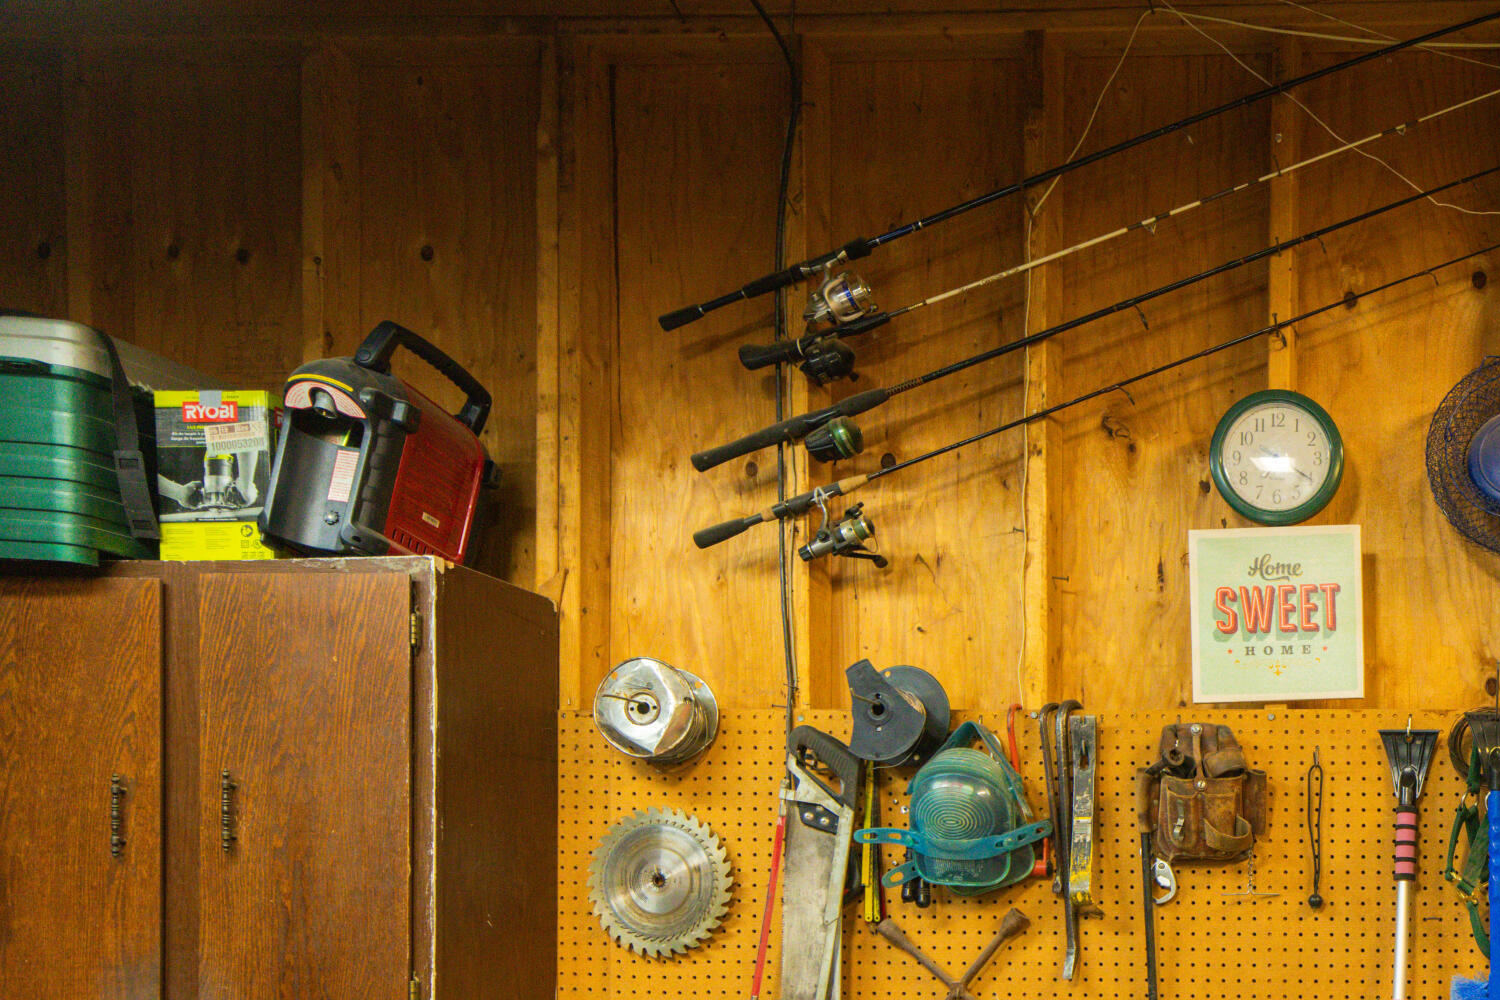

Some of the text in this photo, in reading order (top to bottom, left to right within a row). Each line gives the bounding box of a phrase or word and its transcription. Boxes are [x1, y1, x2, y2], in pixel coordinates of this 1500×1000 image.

[185, 403, 235, 420] RYOBI
[1254, 418, 1266, 433] 11
[1270, 412, 1286, 428] 12
[1294, 418, 1300, 433] 1
[1239, 431, 1254, 447] 10
[1306, 431, 1317, 447] 2
[1232, 450, 1242, 467] 9
[1312, 451, 1323, 467] 3
[1239, 471, 1249, 487] 8
[1255, 485, 1264, 500] 7
[1272, 489, 1282, 505] 6
[1291, 485, 1302, 501] 5
[1247, 553, 1304, 582] Home
[1215, 582, 1342, 635] SWEET
[1244, 645, 1312, 656] HOME
